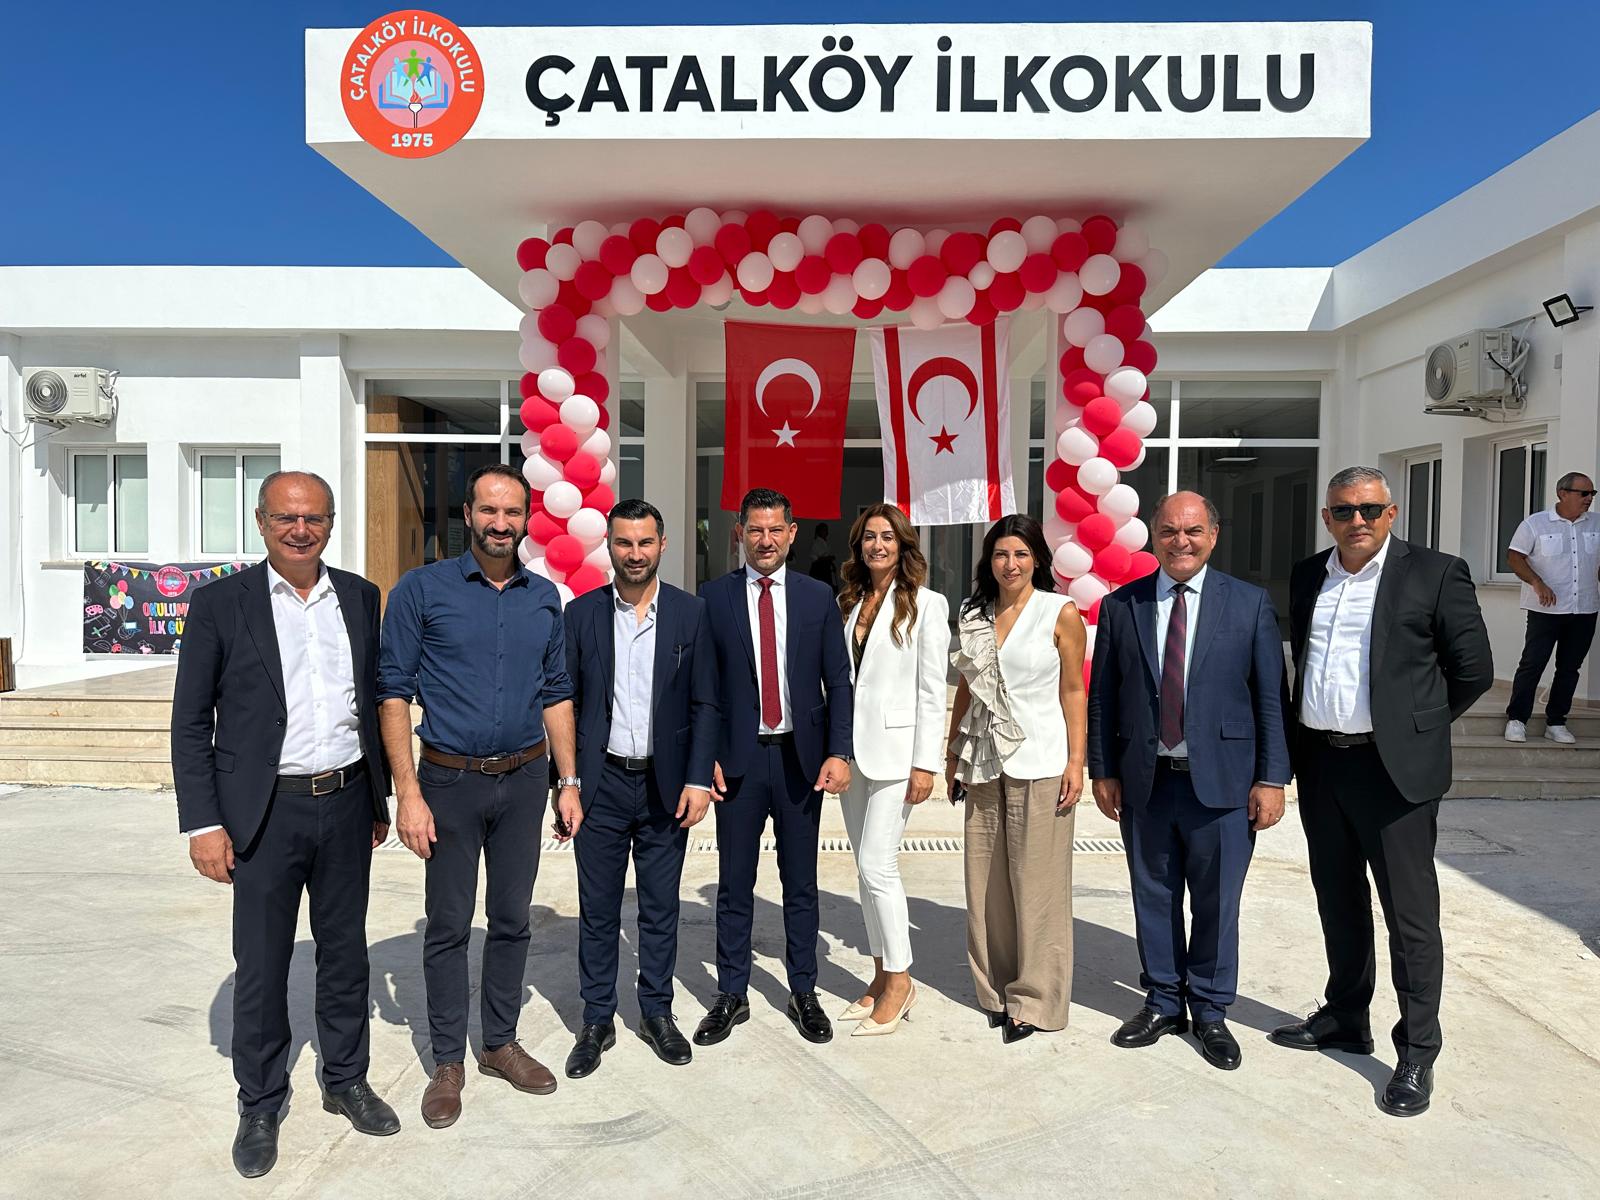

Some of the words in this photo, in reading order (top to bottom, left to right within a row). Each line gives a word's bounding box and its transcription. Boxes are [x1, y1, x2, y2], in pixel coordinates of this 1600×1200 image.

[350, 20, 406, 101] ÇATALKÖY
[413, 16, 475, 92] İLKOKULU
[526, 36, 912, 126] ÇATALKÖY
[937, 36, 1314, 112] İLKOKULU
[391, 133, 433, 147] 1975
[168, 618, 185, 635] GÜ
